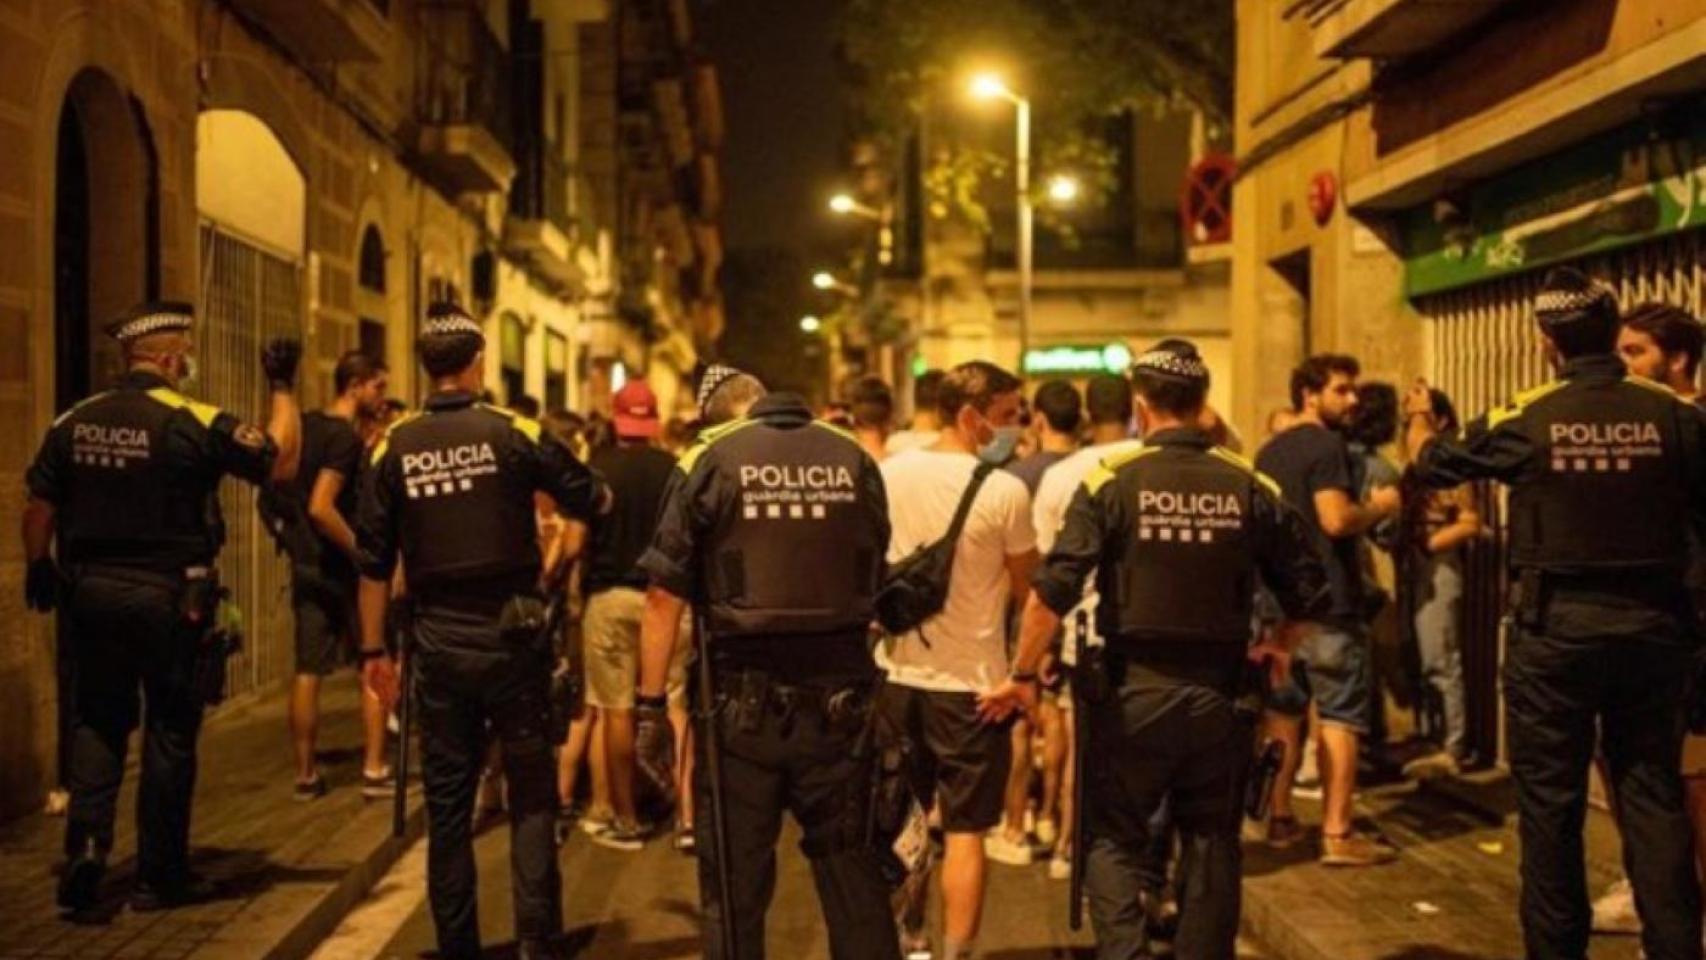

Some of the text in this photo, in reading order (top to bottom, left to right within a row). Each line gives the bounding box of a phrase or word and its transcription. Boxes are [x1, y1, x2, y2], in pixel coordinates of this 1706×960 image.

[74, 423, 149, 447] POLICIA
[1550, 422, 1660, 444] POLICIA
[402, 442, 496, 474] POLICIA
[740, 465, 854, 488] POLICIA
[1139, 490, 1241, 515] POLICIA
